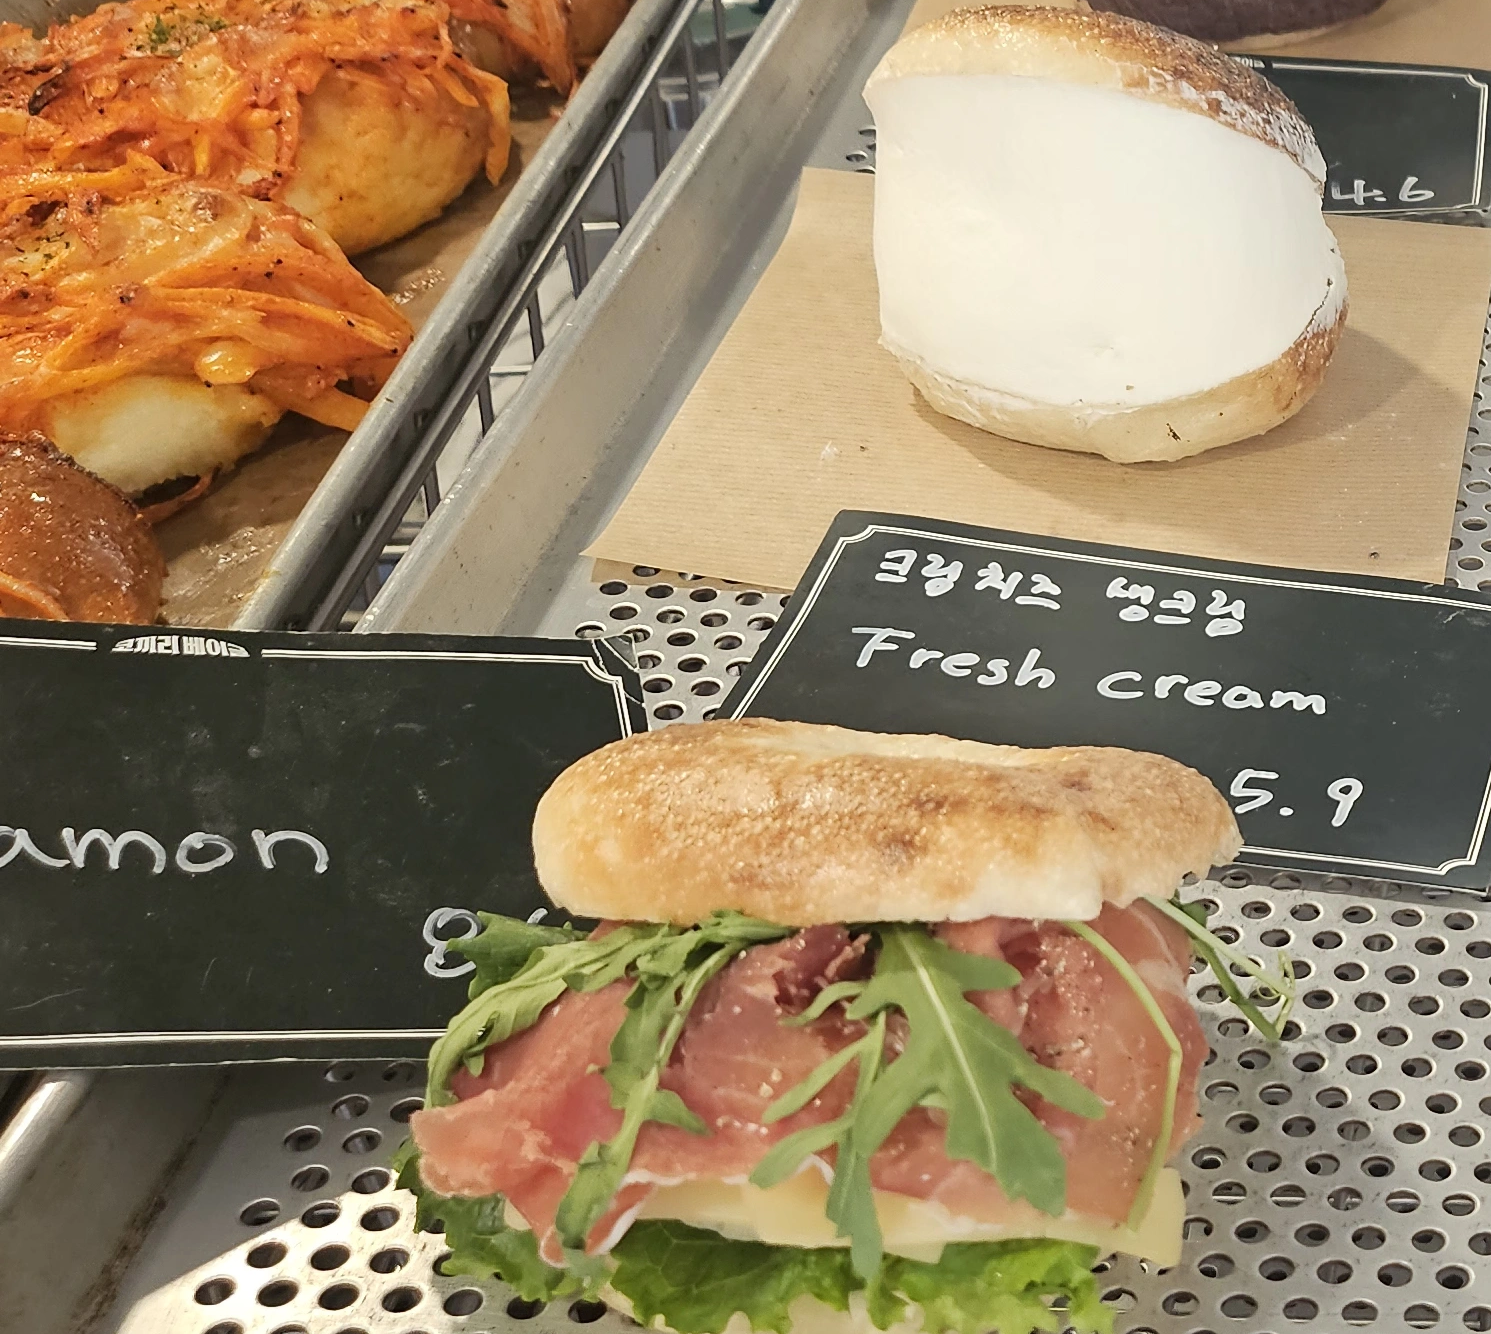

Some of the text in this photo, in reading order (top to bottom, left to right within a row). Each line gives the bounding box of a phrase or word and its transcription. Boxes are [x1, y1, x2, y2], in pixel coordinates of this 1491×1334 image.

[1331, 176, 1435, 206] 4.6
[874, 548, 1246, 638] 크림치즈 생크림
[851, 626, 1328, 715] Fresh cream
[1229, 768, 1364, 827] 5.9
